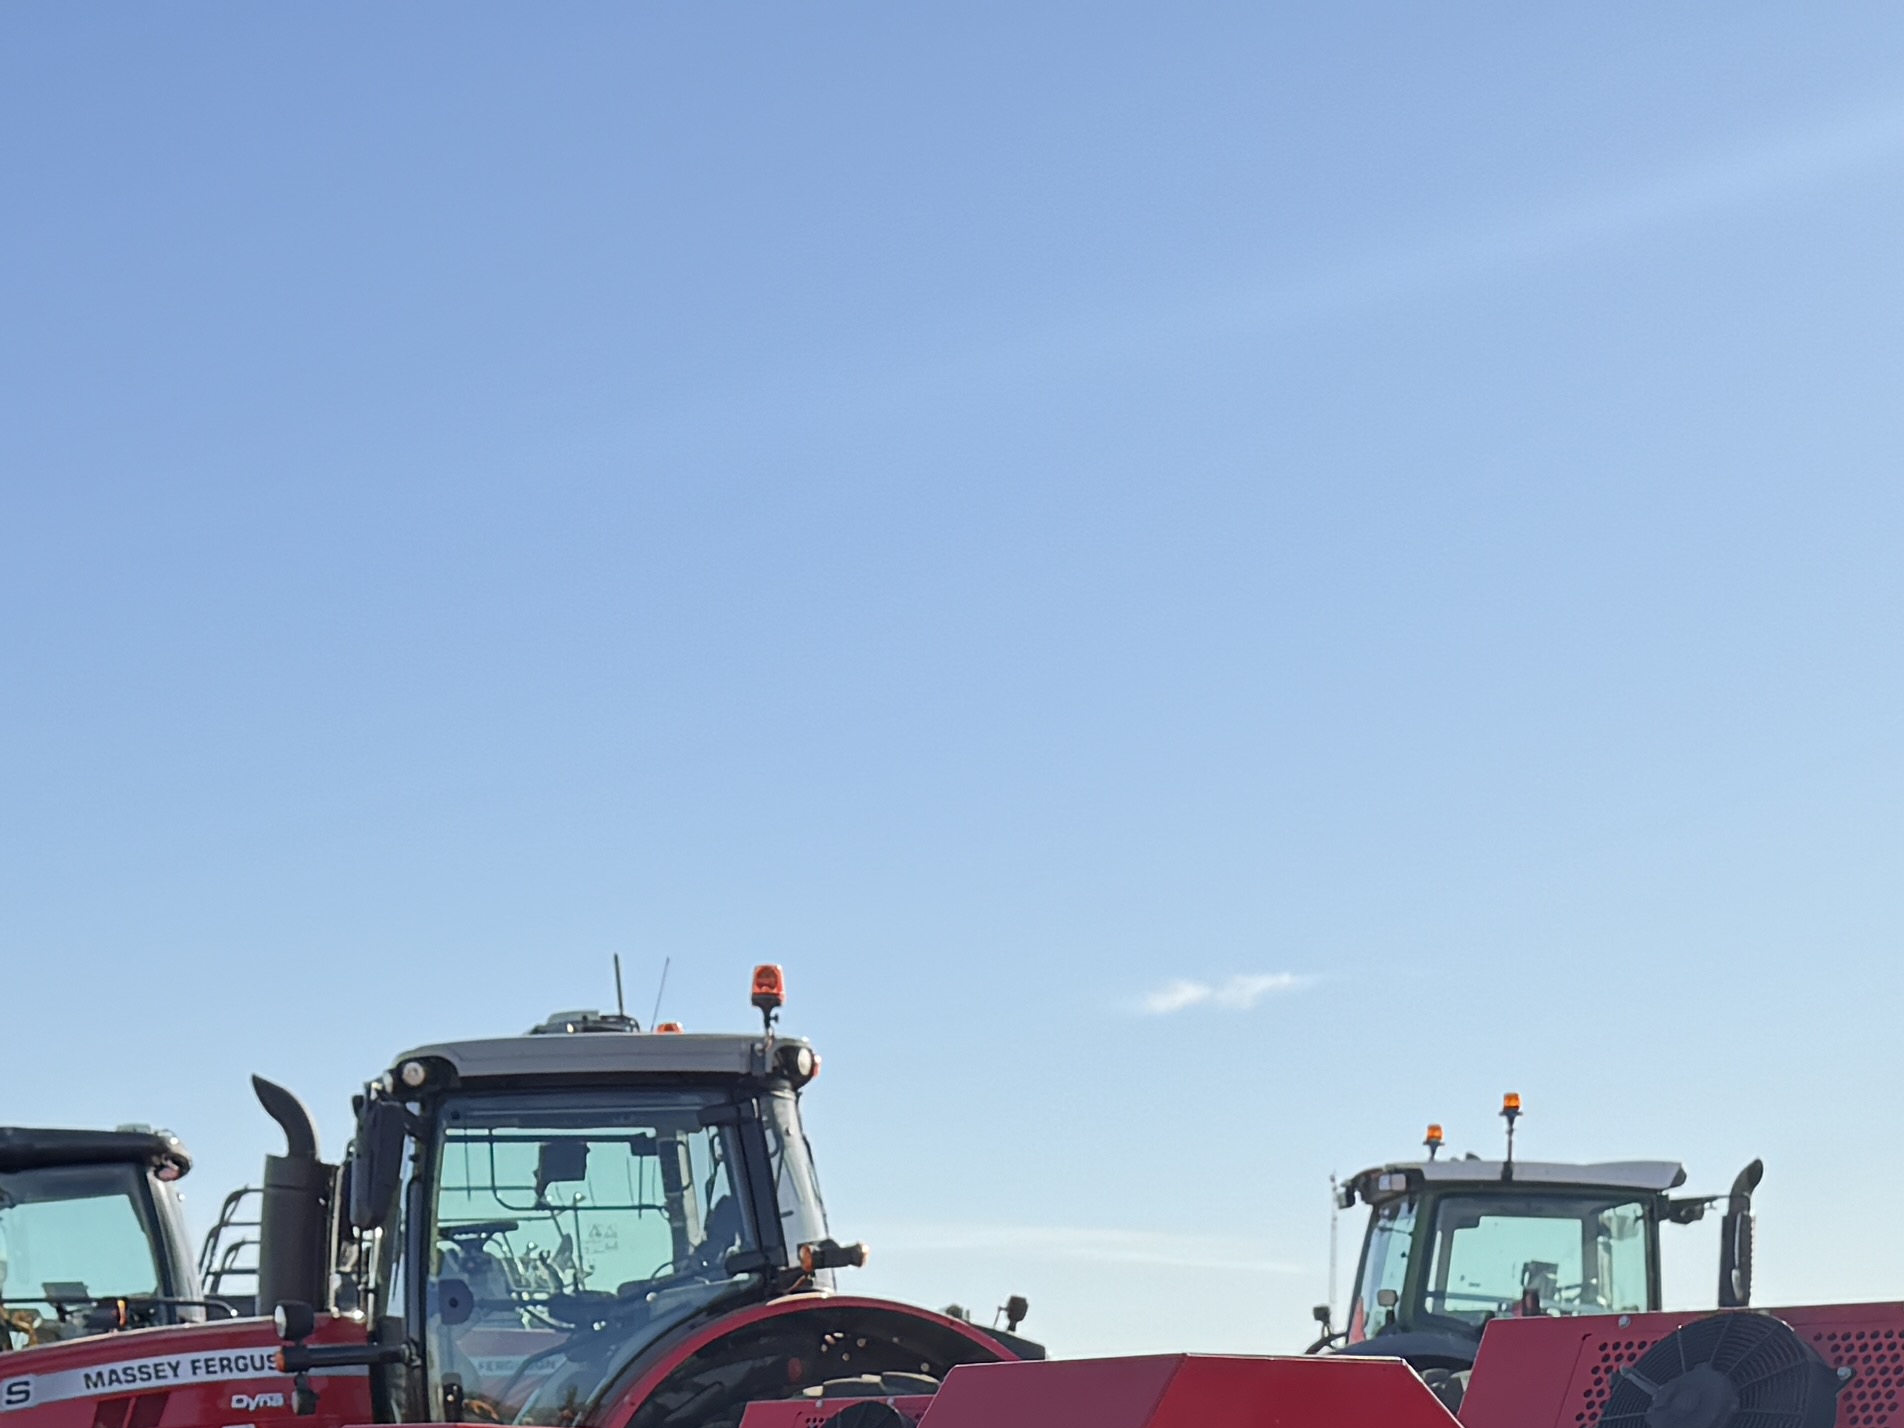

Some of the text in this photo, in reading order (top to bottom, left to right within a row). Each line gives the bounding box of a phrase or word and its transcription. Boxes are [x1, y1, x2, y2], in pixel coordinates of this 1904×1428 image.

[5, 1380, 31, 1405] S
[83, 1359, 181, 1390] MASSEY
[190, 1353, 278, 1376] FERGUS
